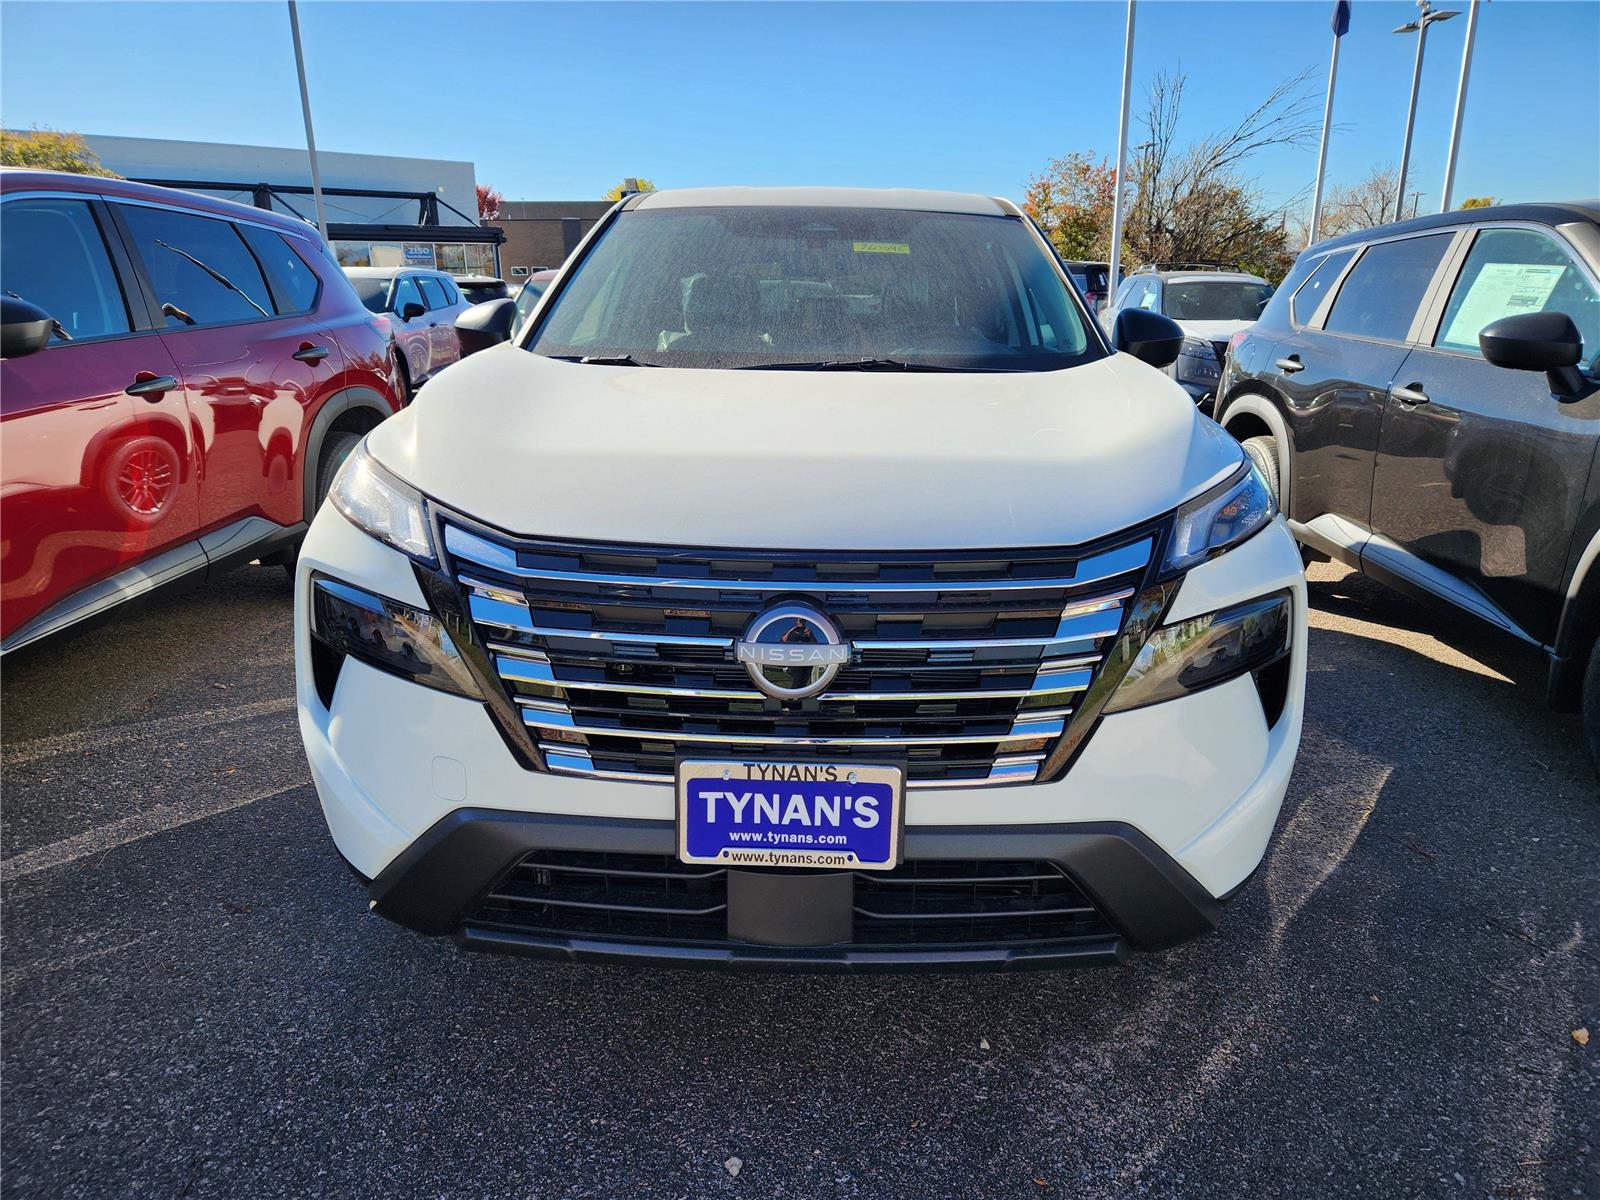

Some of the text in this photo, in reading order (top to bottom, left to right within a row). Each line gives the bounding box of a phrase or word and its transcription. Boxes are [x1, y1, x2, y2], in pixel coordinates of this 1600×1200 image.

[740, 646, 845, 662] NISSAN
[743, 763, 838, 782] TYNAN'S
[698, 791, 879, 829] TYNAN'S
[729, 831, 847, 845] www.tynans.com
[731, 852, 846, 866] www.tynans.com
